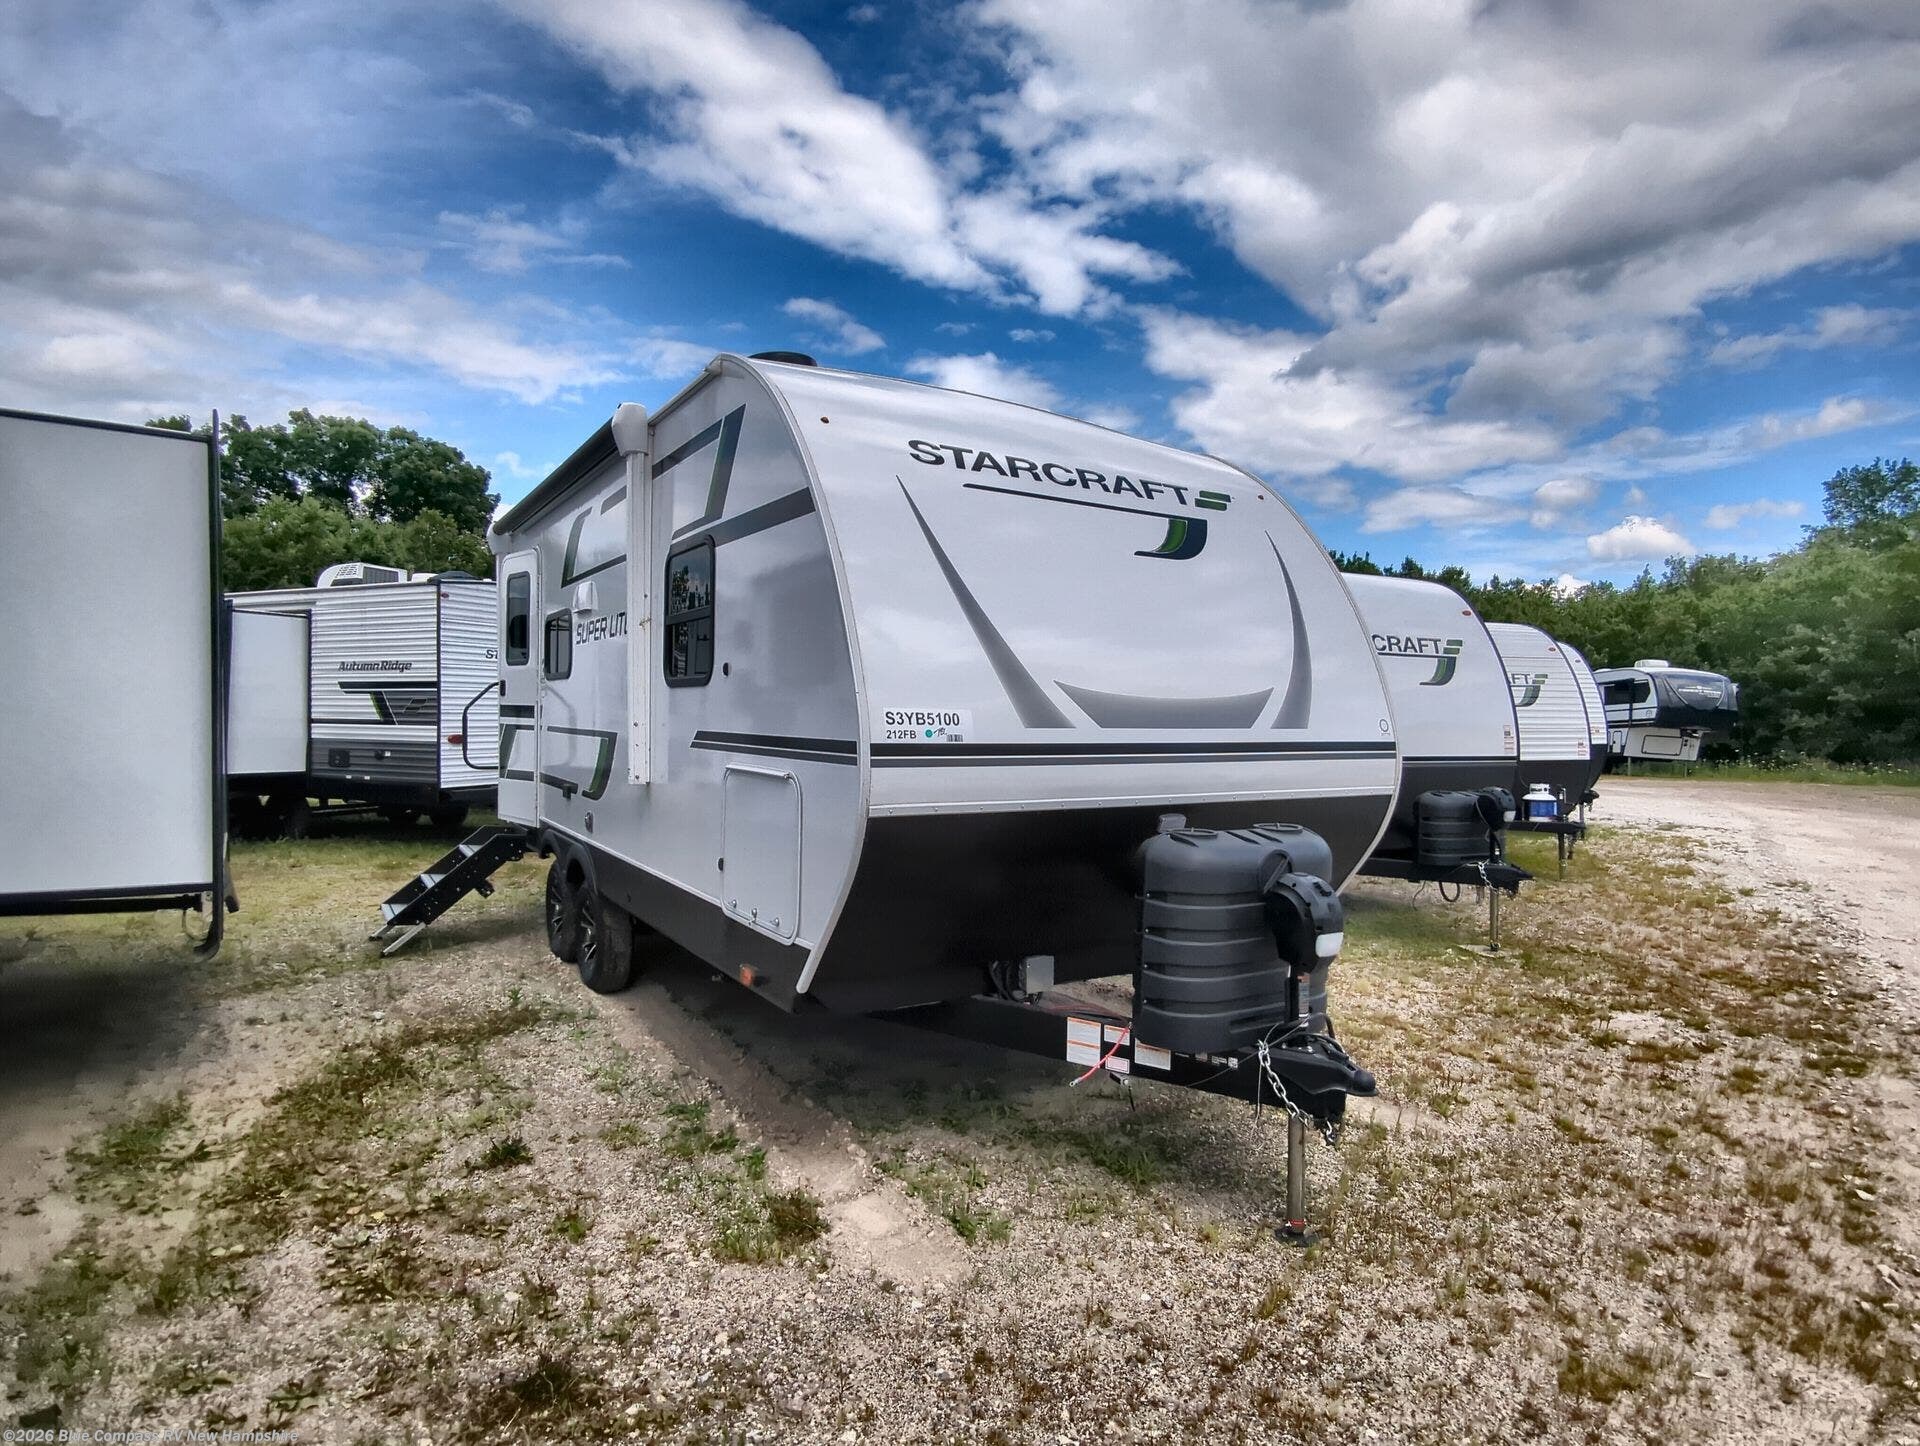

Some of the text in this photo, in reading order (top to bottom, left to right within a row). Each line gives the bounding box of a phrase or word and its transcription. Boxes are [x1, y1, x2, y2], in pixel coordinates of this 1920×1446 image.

[908, 439, 1189, 505] STARCRAFT
[575, 616, 607, 645] SUPER
[1508, 673, 1531, 684] FT
[885, 711, 960, 726] S3YB5100
[886, 729, 917, 739] 212FB
